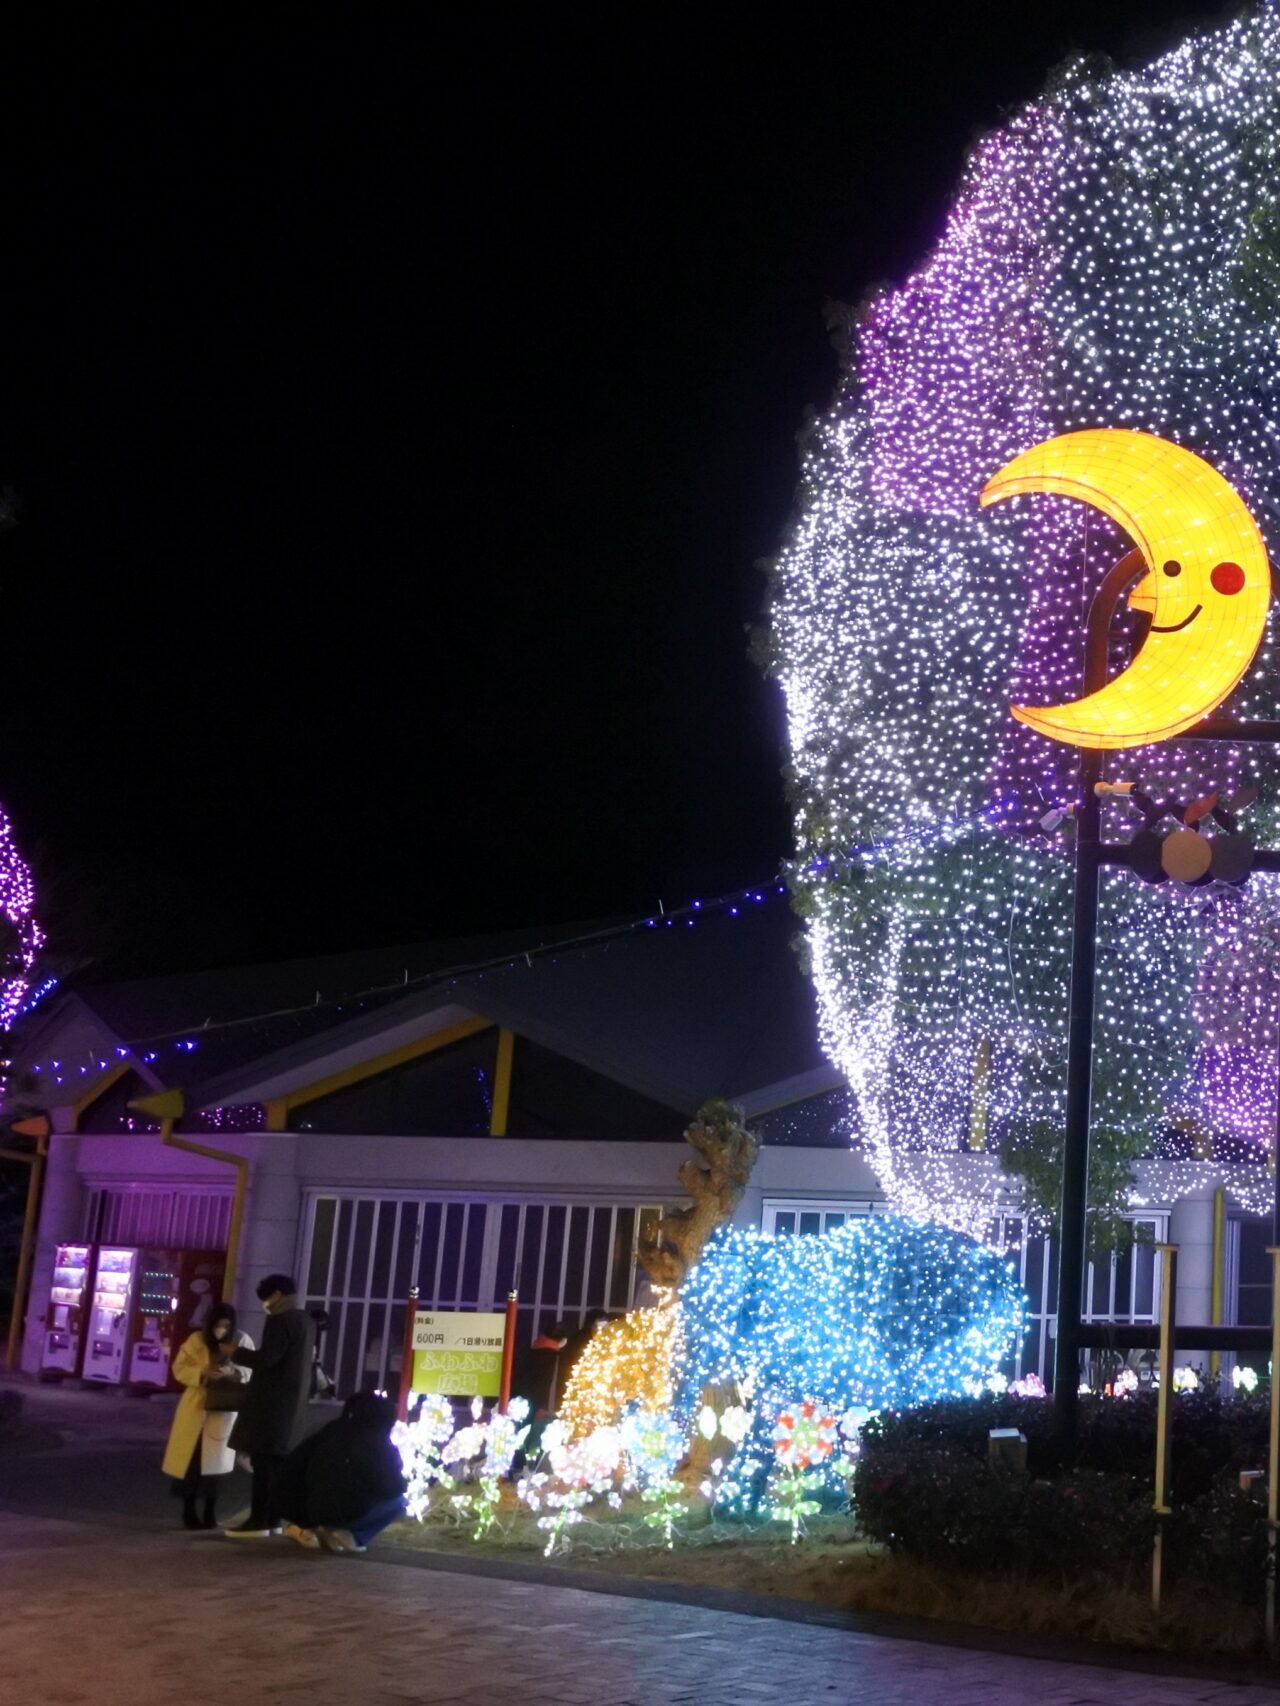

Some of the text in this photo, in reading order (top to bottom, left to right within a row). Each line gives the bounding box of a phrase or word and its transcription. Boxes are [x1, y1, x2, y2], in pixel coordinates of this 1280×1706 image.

[416, 1333, 444, 1344] 600円
[421, 1351, 498, 1372] ふわふわ
